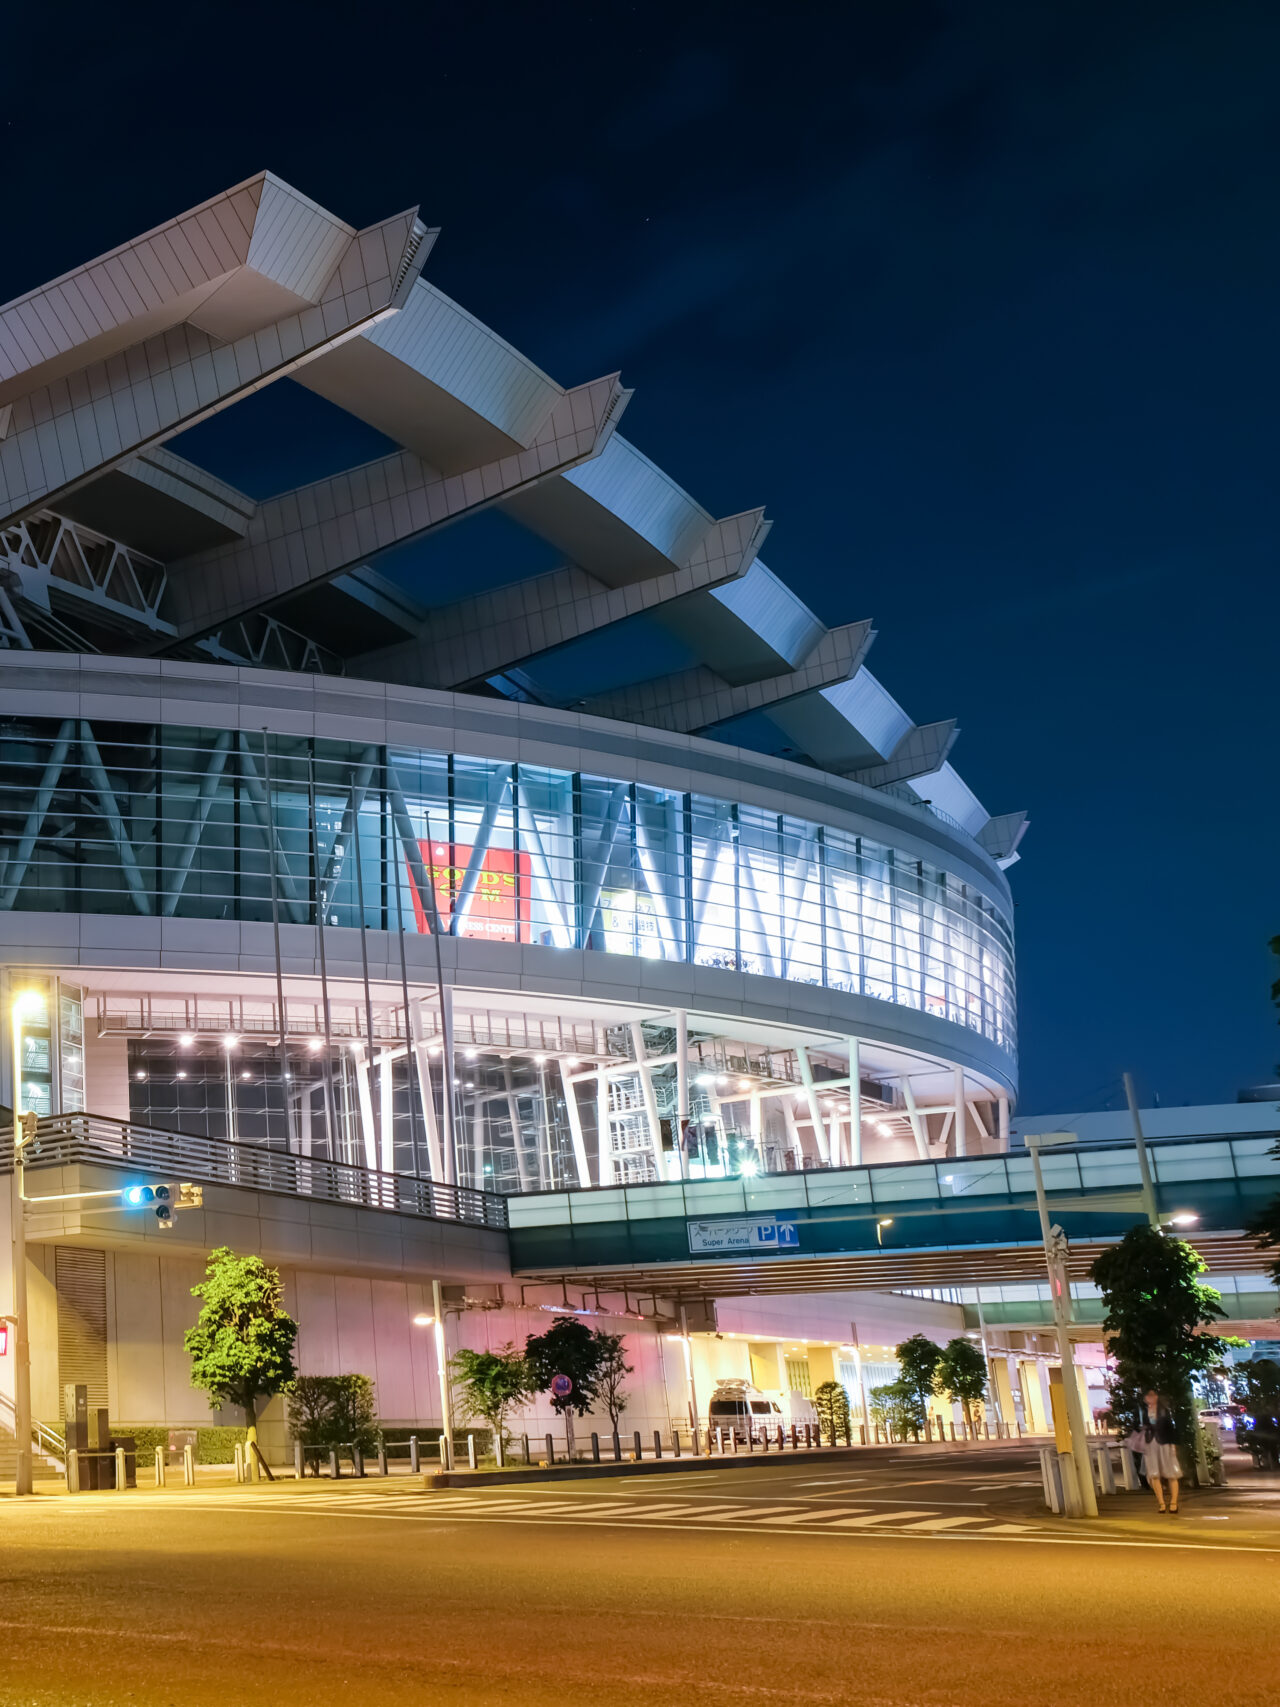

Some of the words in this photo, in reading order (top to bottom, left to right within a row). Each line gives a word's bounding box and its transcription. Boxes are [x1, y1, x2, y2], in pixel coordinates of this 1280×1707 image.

[424, 865, 515, 887] GOD'S
[702, 1239, 723, 1248] Super
[727, 1237, 750, 1246] Arena
